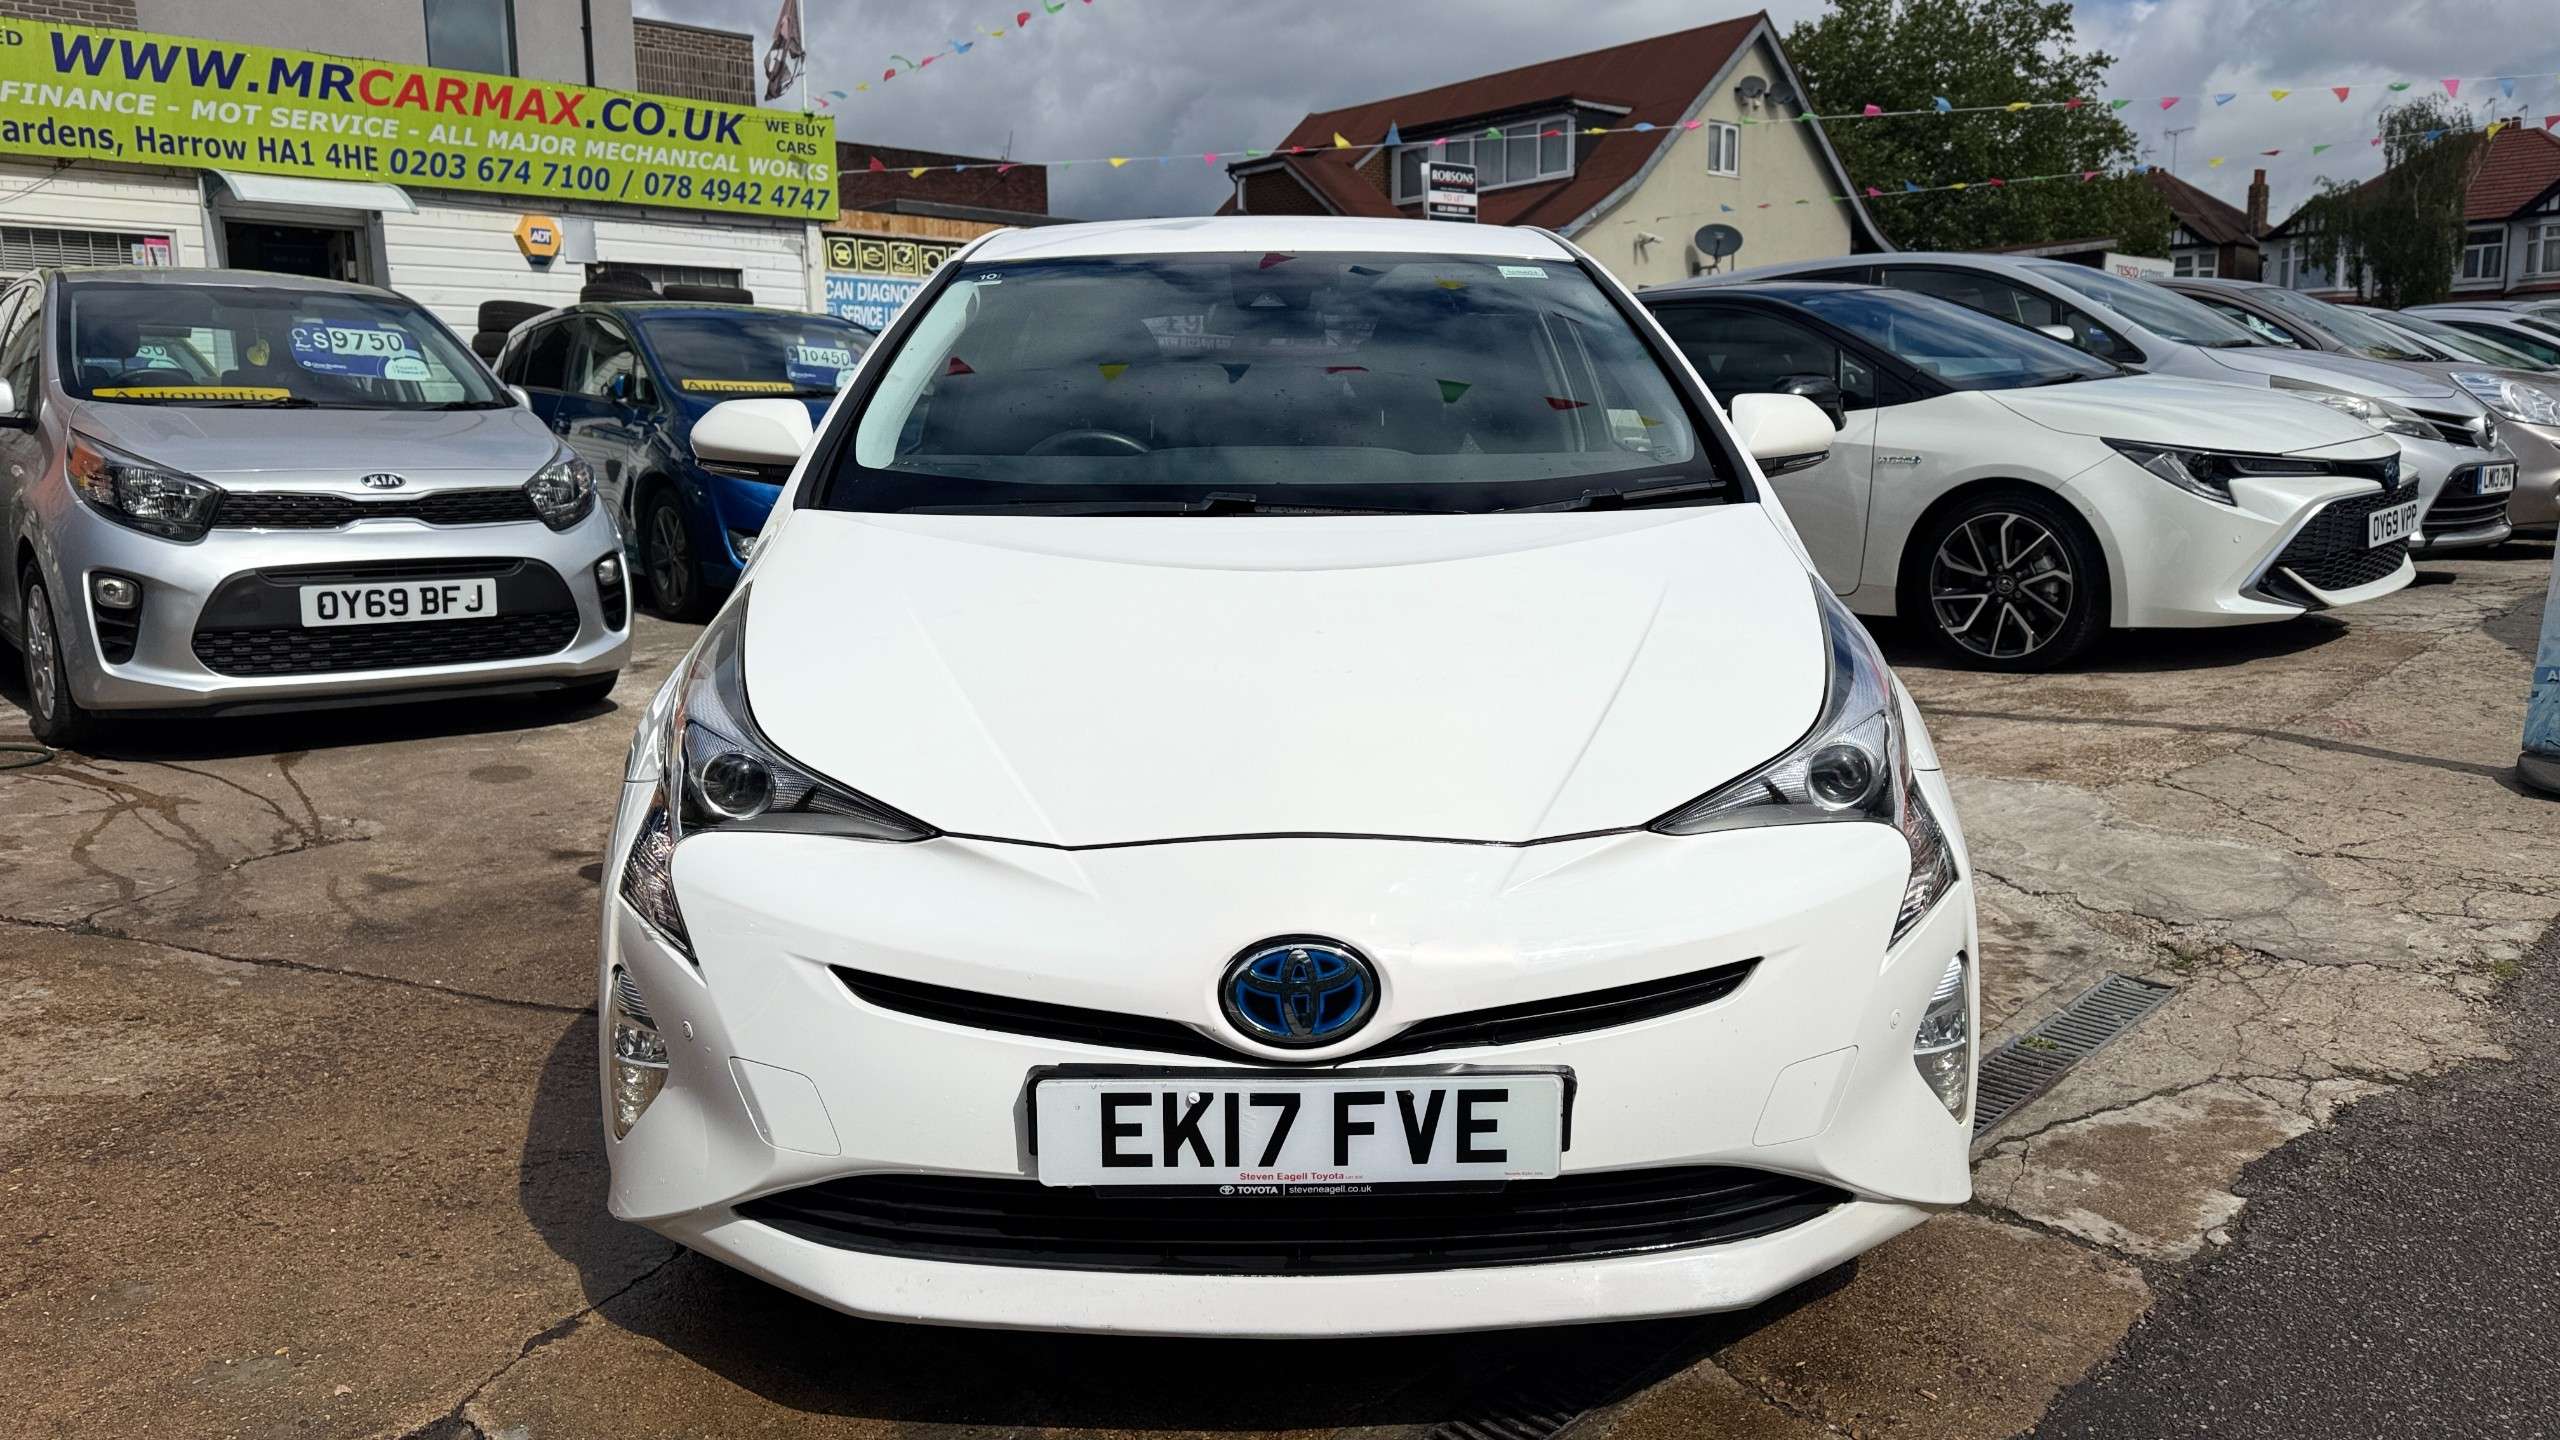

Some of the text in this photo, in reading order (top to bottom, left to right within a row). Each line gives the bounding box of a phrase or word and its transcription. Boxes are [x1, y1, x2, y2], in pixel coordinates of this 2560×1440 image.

[50, 31, 745, 145] WWW.MRCARMAX.CO.UK
[0, 80, 157, 116] FINANCE
[191, 99, 262, 125] MOT
[270, 107, 399, 139] SERVICE
[428, 124, 478, 147] ALL
[487, 130, 577, 157] MAJOR
[585, 140, 741, 173] MECHANICAL
[749, 157, 829, 182] WORKS
[765, 119, 826, 138] WE BUY
[776, 139, 817, 156] CARS
[135, 125, 247, 161] Harrow
[258, 136, 315, 166] HA1
[325, 143, 379, 172] 4HE
[390, 148, 466, 179] 0203
[477, 156, 531, 185] 674
[542, 162, 610, 192] 7100
[644, 172, 692, 199] 078
[700, 178, 762, 205] 4942
[770, 185, 831, 211] 4747
[1432, 169, 1474, 185] ROBSONS
[531, 229, 552, 244] ADT
[825, 279, 853, 301] CAN
[841, 303, 883, 326] SERVICE
[367, 474, 399, 486] KIA
[2373, 503, 2417, 541] OY69 VPP
[317, 584, 482, 620] OY69 BFJ
[1101, 1088, 1509, 1168] EK17 FVE
[1240, 1172, 1344, 1182] Steven Eagell Toyota
[1237, 1185, 1372, 1194] TOYOTA steveneagell.co.uk
